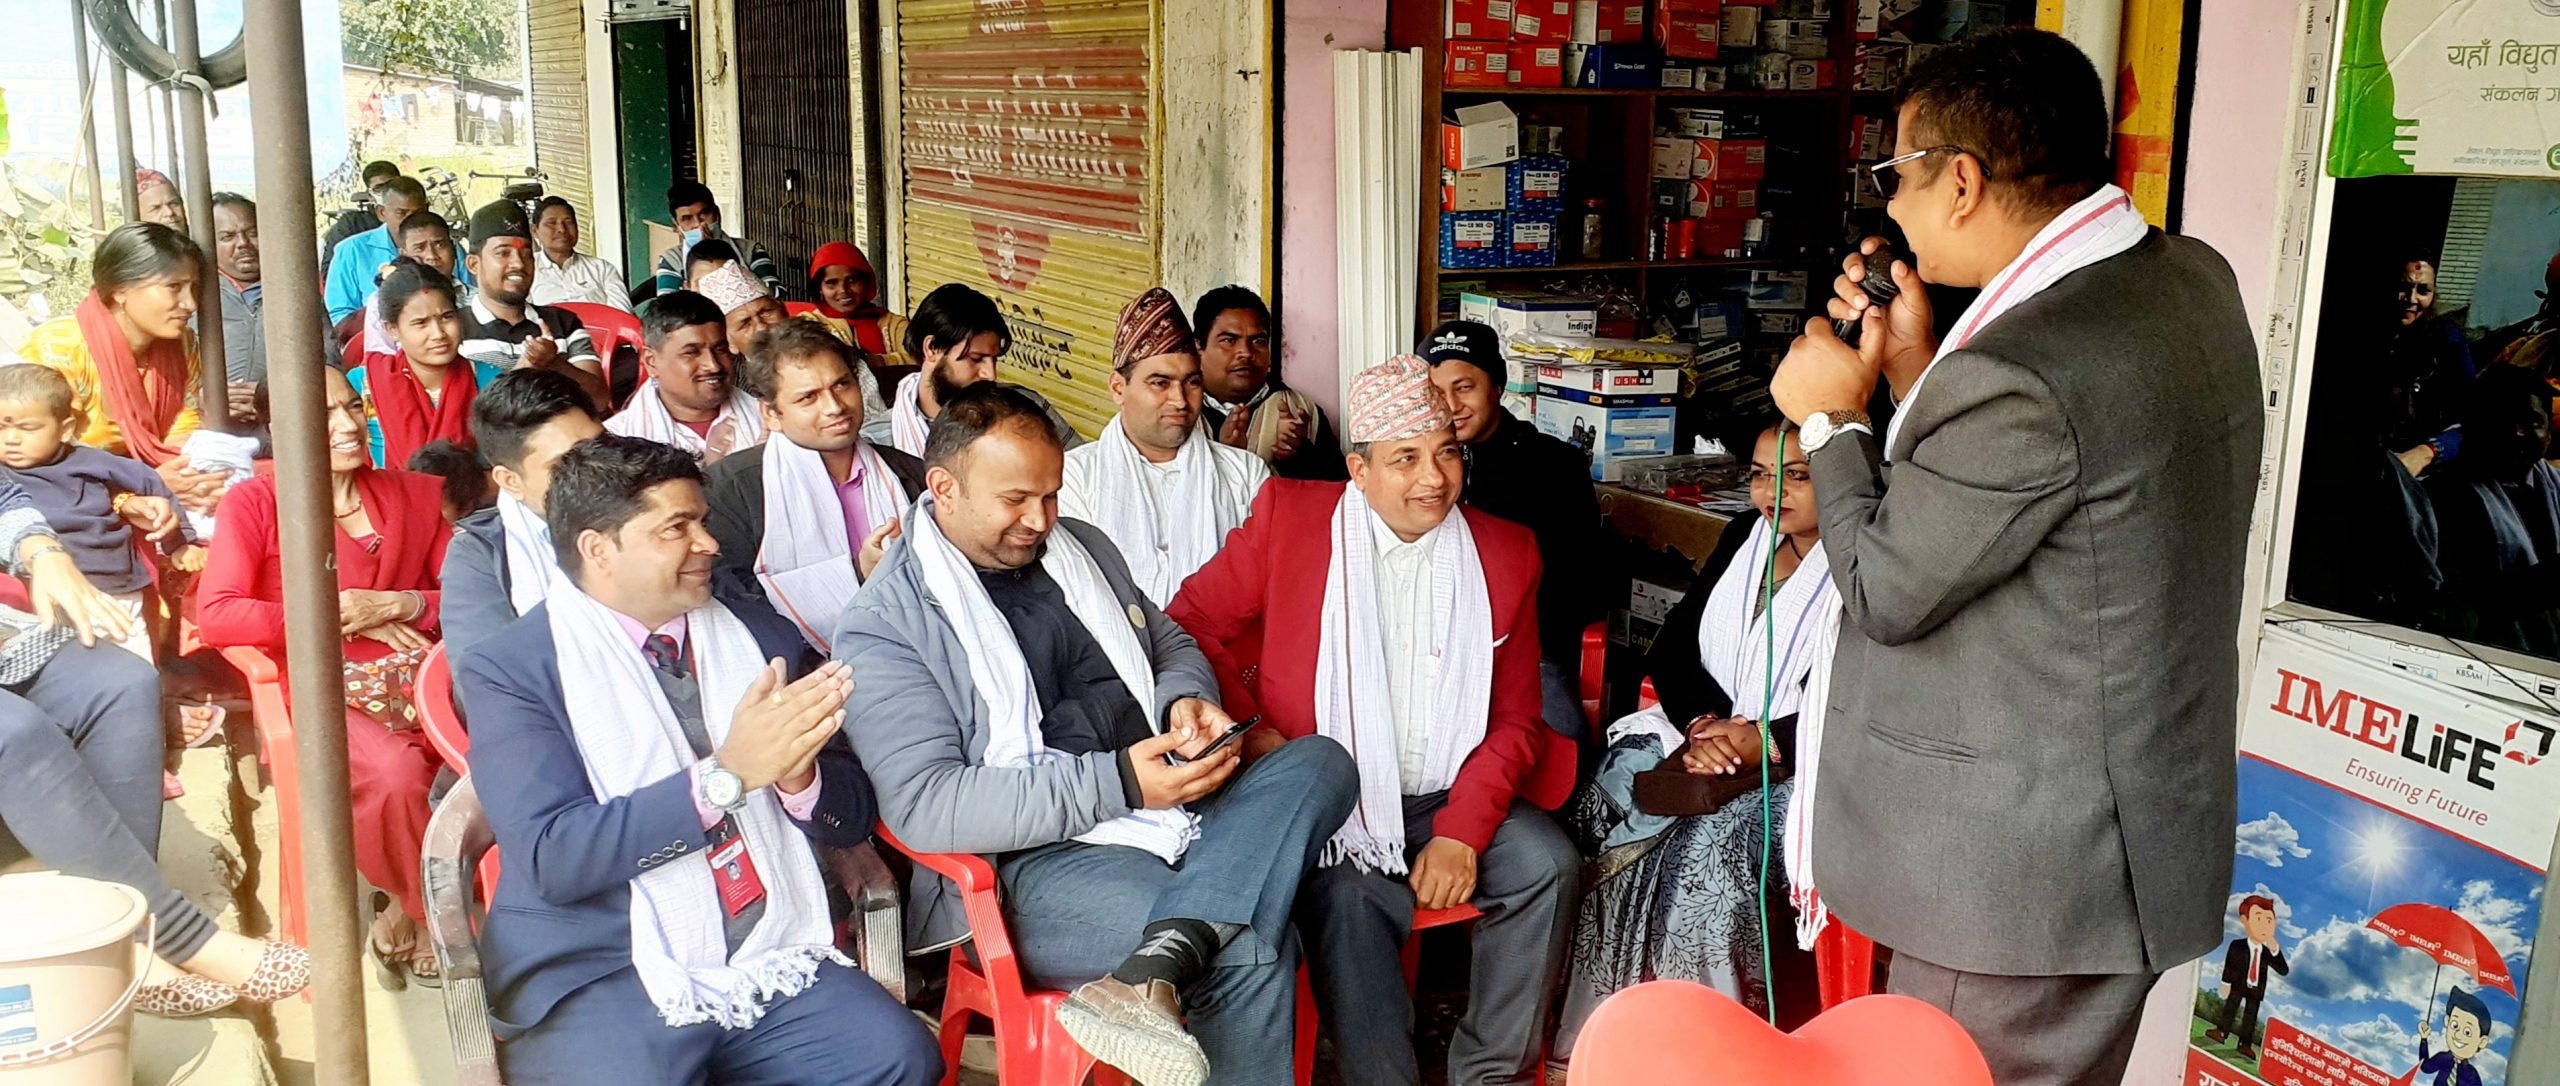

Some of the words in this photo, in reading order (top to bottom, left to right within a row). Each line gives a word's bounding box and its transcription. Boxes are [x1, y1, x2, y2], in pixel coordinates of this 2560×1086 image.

[2447, 38, 2492, 69] यहाँ
[2499, 39, 2560, 73] विद्युत
[2480, 84, 2541, 101] संकलन
[1430, 343, 1469, 353] adidas
[2345, 757, 2423, 805] Ensuring
[2425, 788, 2488, 827] Future
